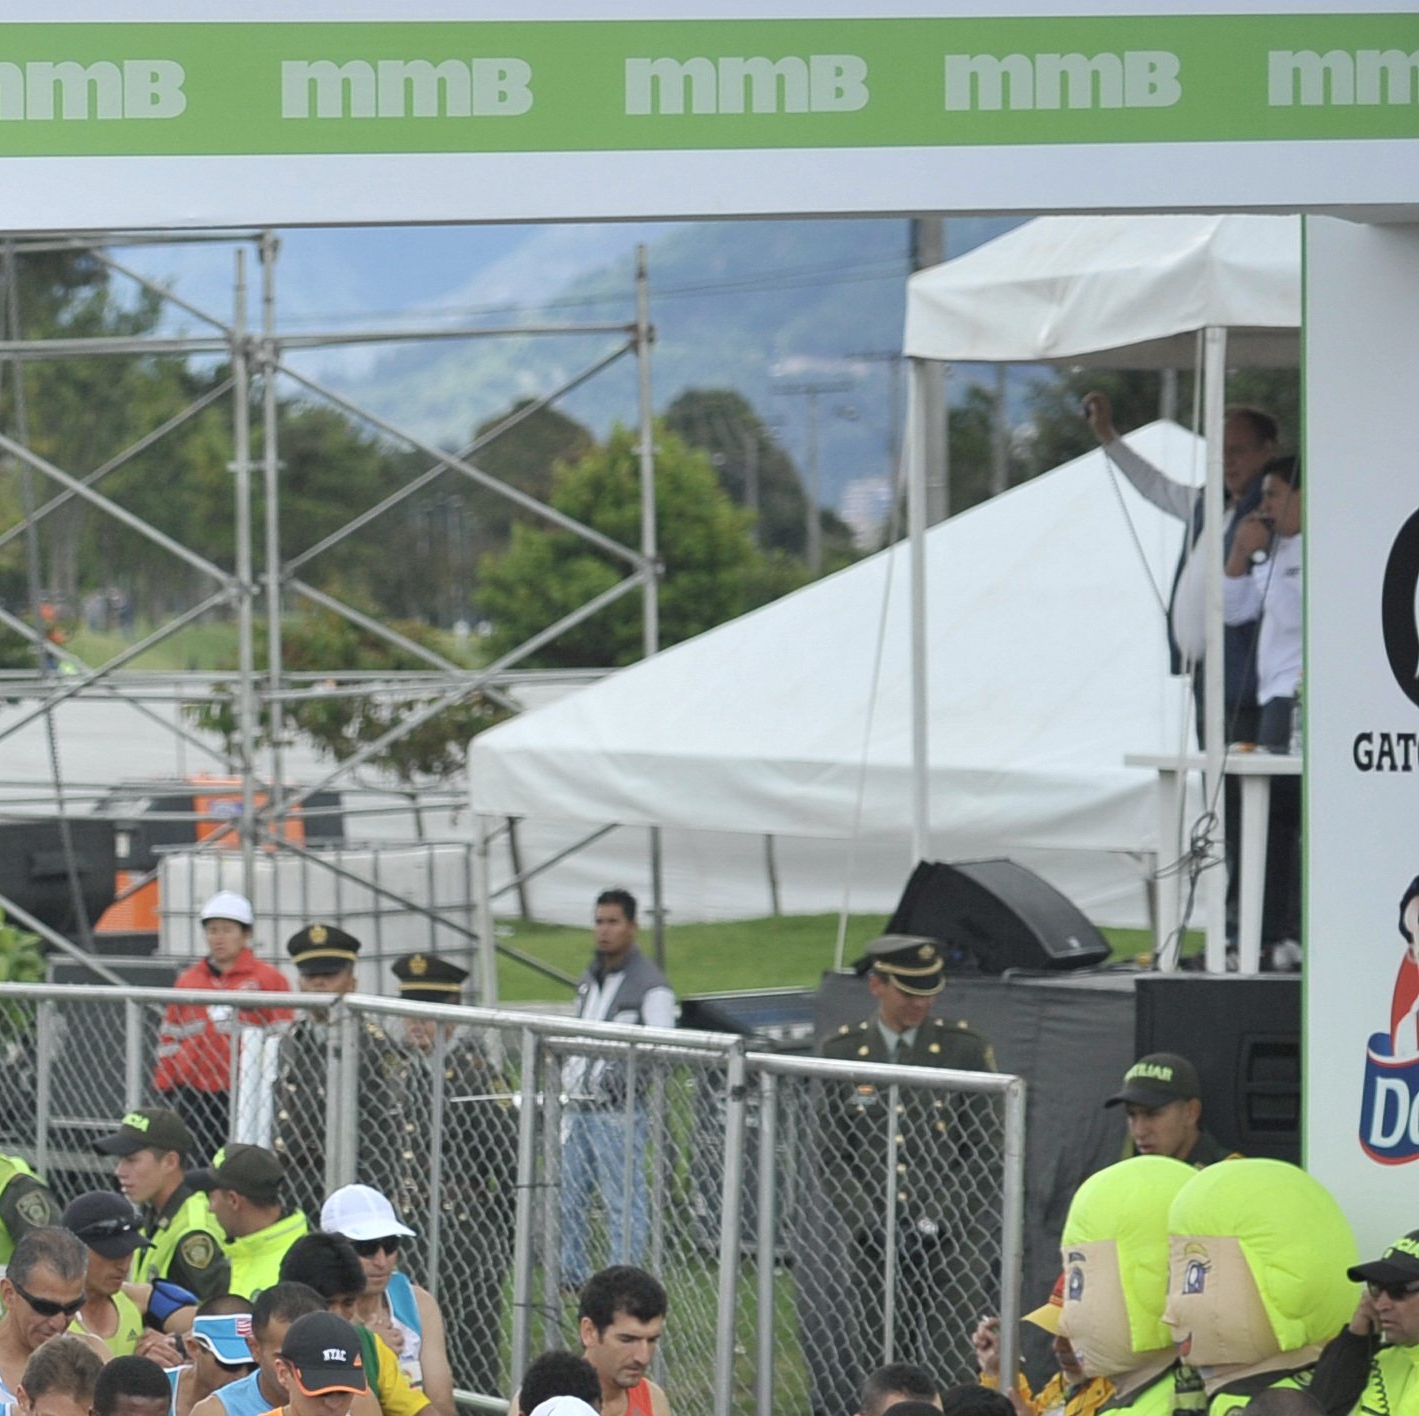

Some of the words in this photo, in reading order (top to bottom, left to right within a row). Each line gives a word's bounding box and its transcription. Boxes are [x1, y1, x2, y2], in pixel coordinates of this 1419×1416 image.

[282, 57, 533, 118] mmB
[624, 53, 869, 114] mmB
[944, 50, 1182, 110] mmB
[1353, 732, 1419, 772] GAT
[323, 1348, 347, 1361] NYAC
